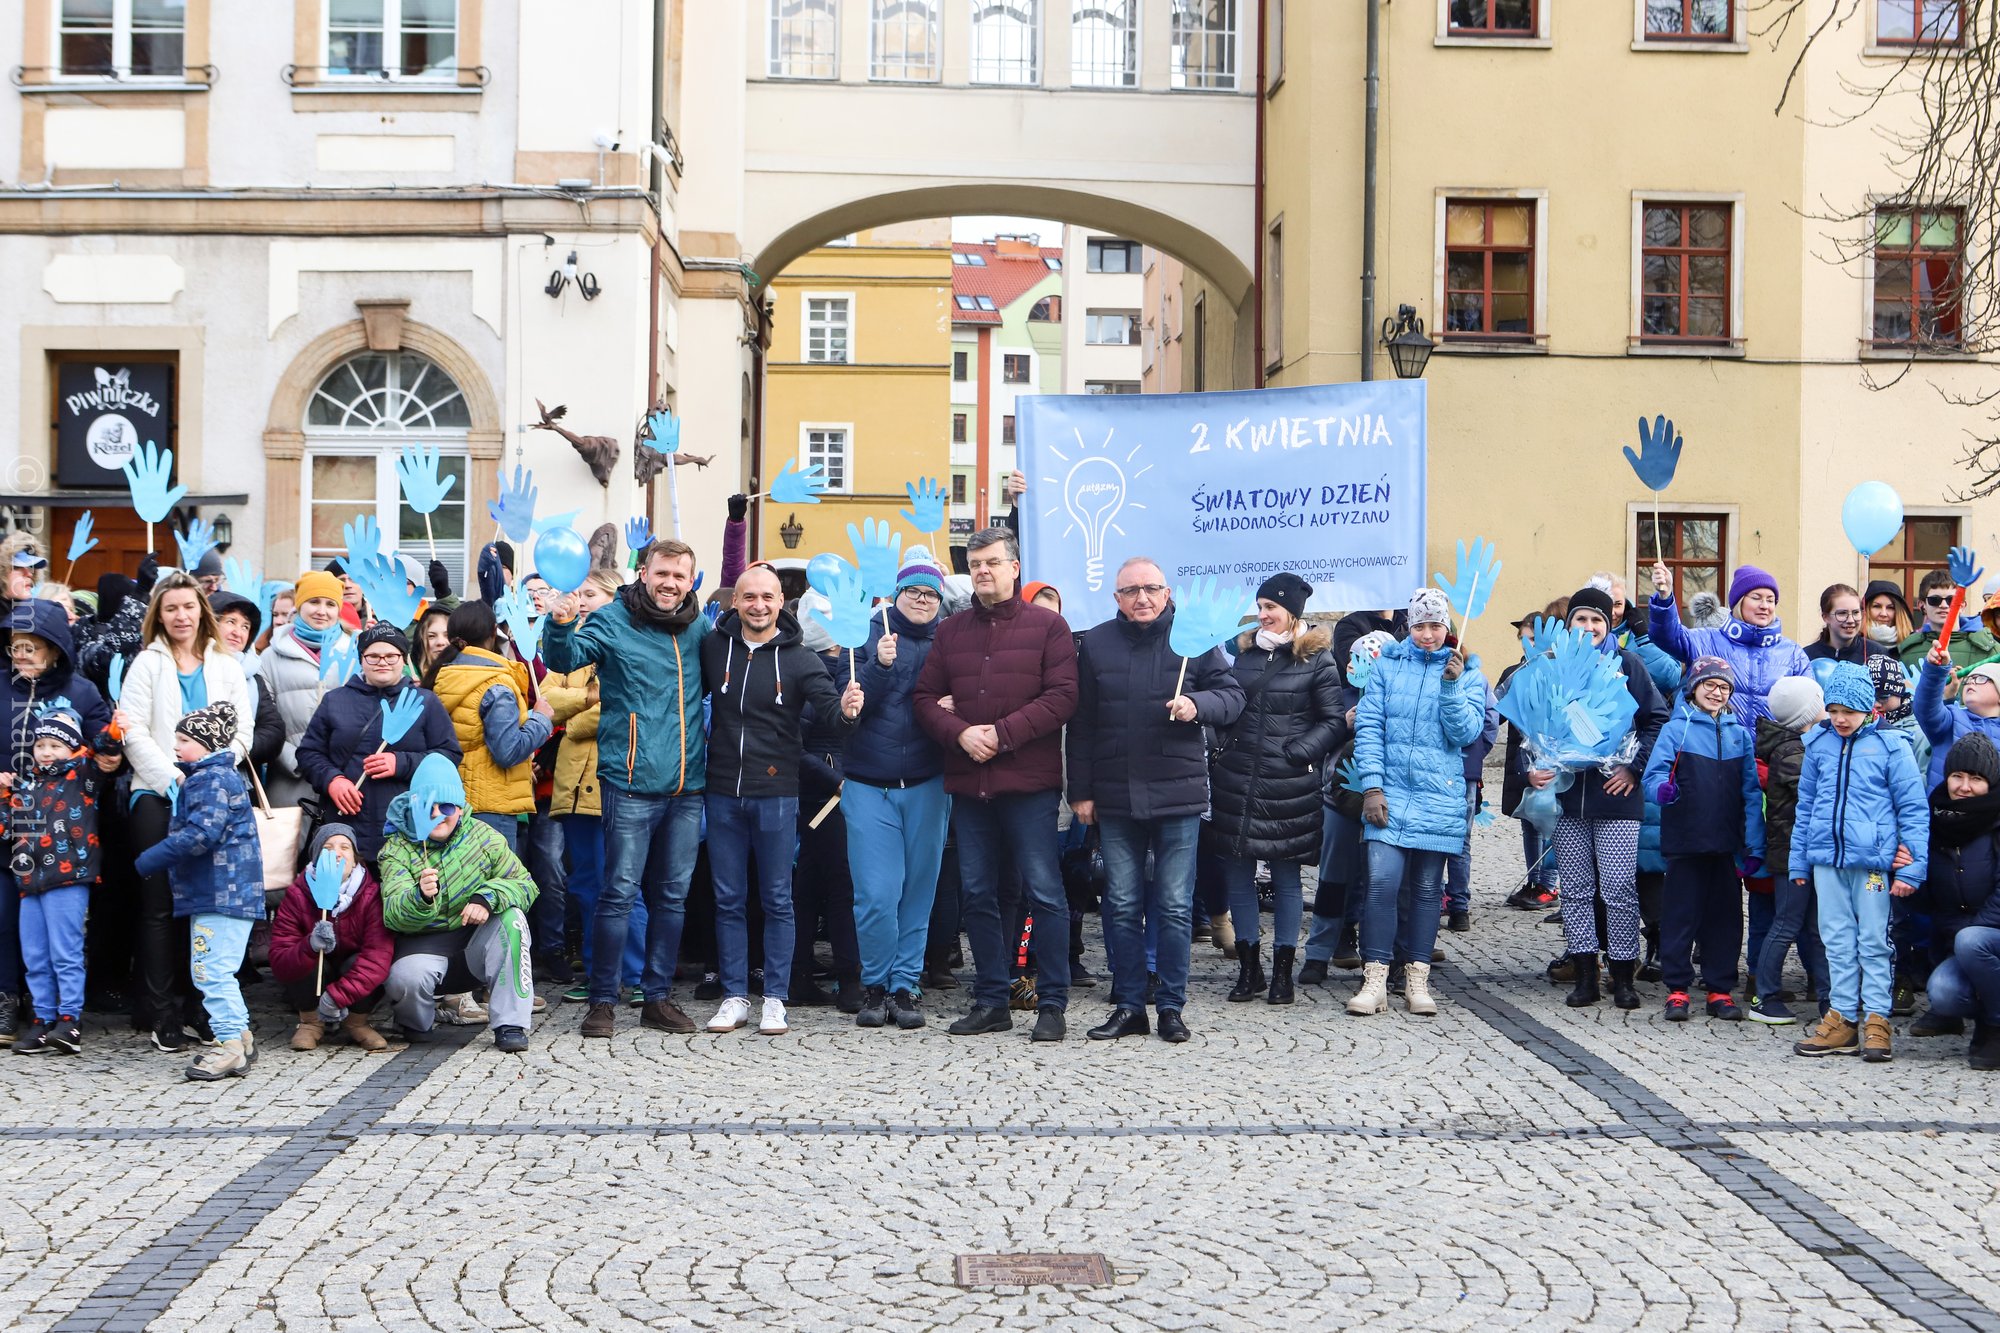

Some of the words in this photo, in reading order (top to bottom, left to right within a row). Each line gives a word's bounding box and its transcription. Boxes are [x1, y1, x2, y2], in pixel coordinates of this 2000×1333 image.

[1189, 422, 1211, 454] 2
[1225, 414, 1393, 452] KWIETNIA
[94, 442, 131, 455] Kozel
[1080, 483, 1116, 495] autyzm
[1191, 483, 1312, 513] ŚWIATOWY
[1321, 473, 1391, 505] DZIEŃ
[1192, 510, 1304, 533] ŚWIADOMOŚCI
[1310, 509, 1390, 527] AUTYZMU
[1177, 564, 1232, 577] SPECJALNY
[1233, 561, 1280, 573] OŚRODEK
[1282, 556, 1408, 571] SZKOLNO-WYCHOWAWCZY
[1245, 577, 1255, 587] W
[1301, 572, 1335, 583] GÓRZE
[35, 724, 70, 741] adidas
